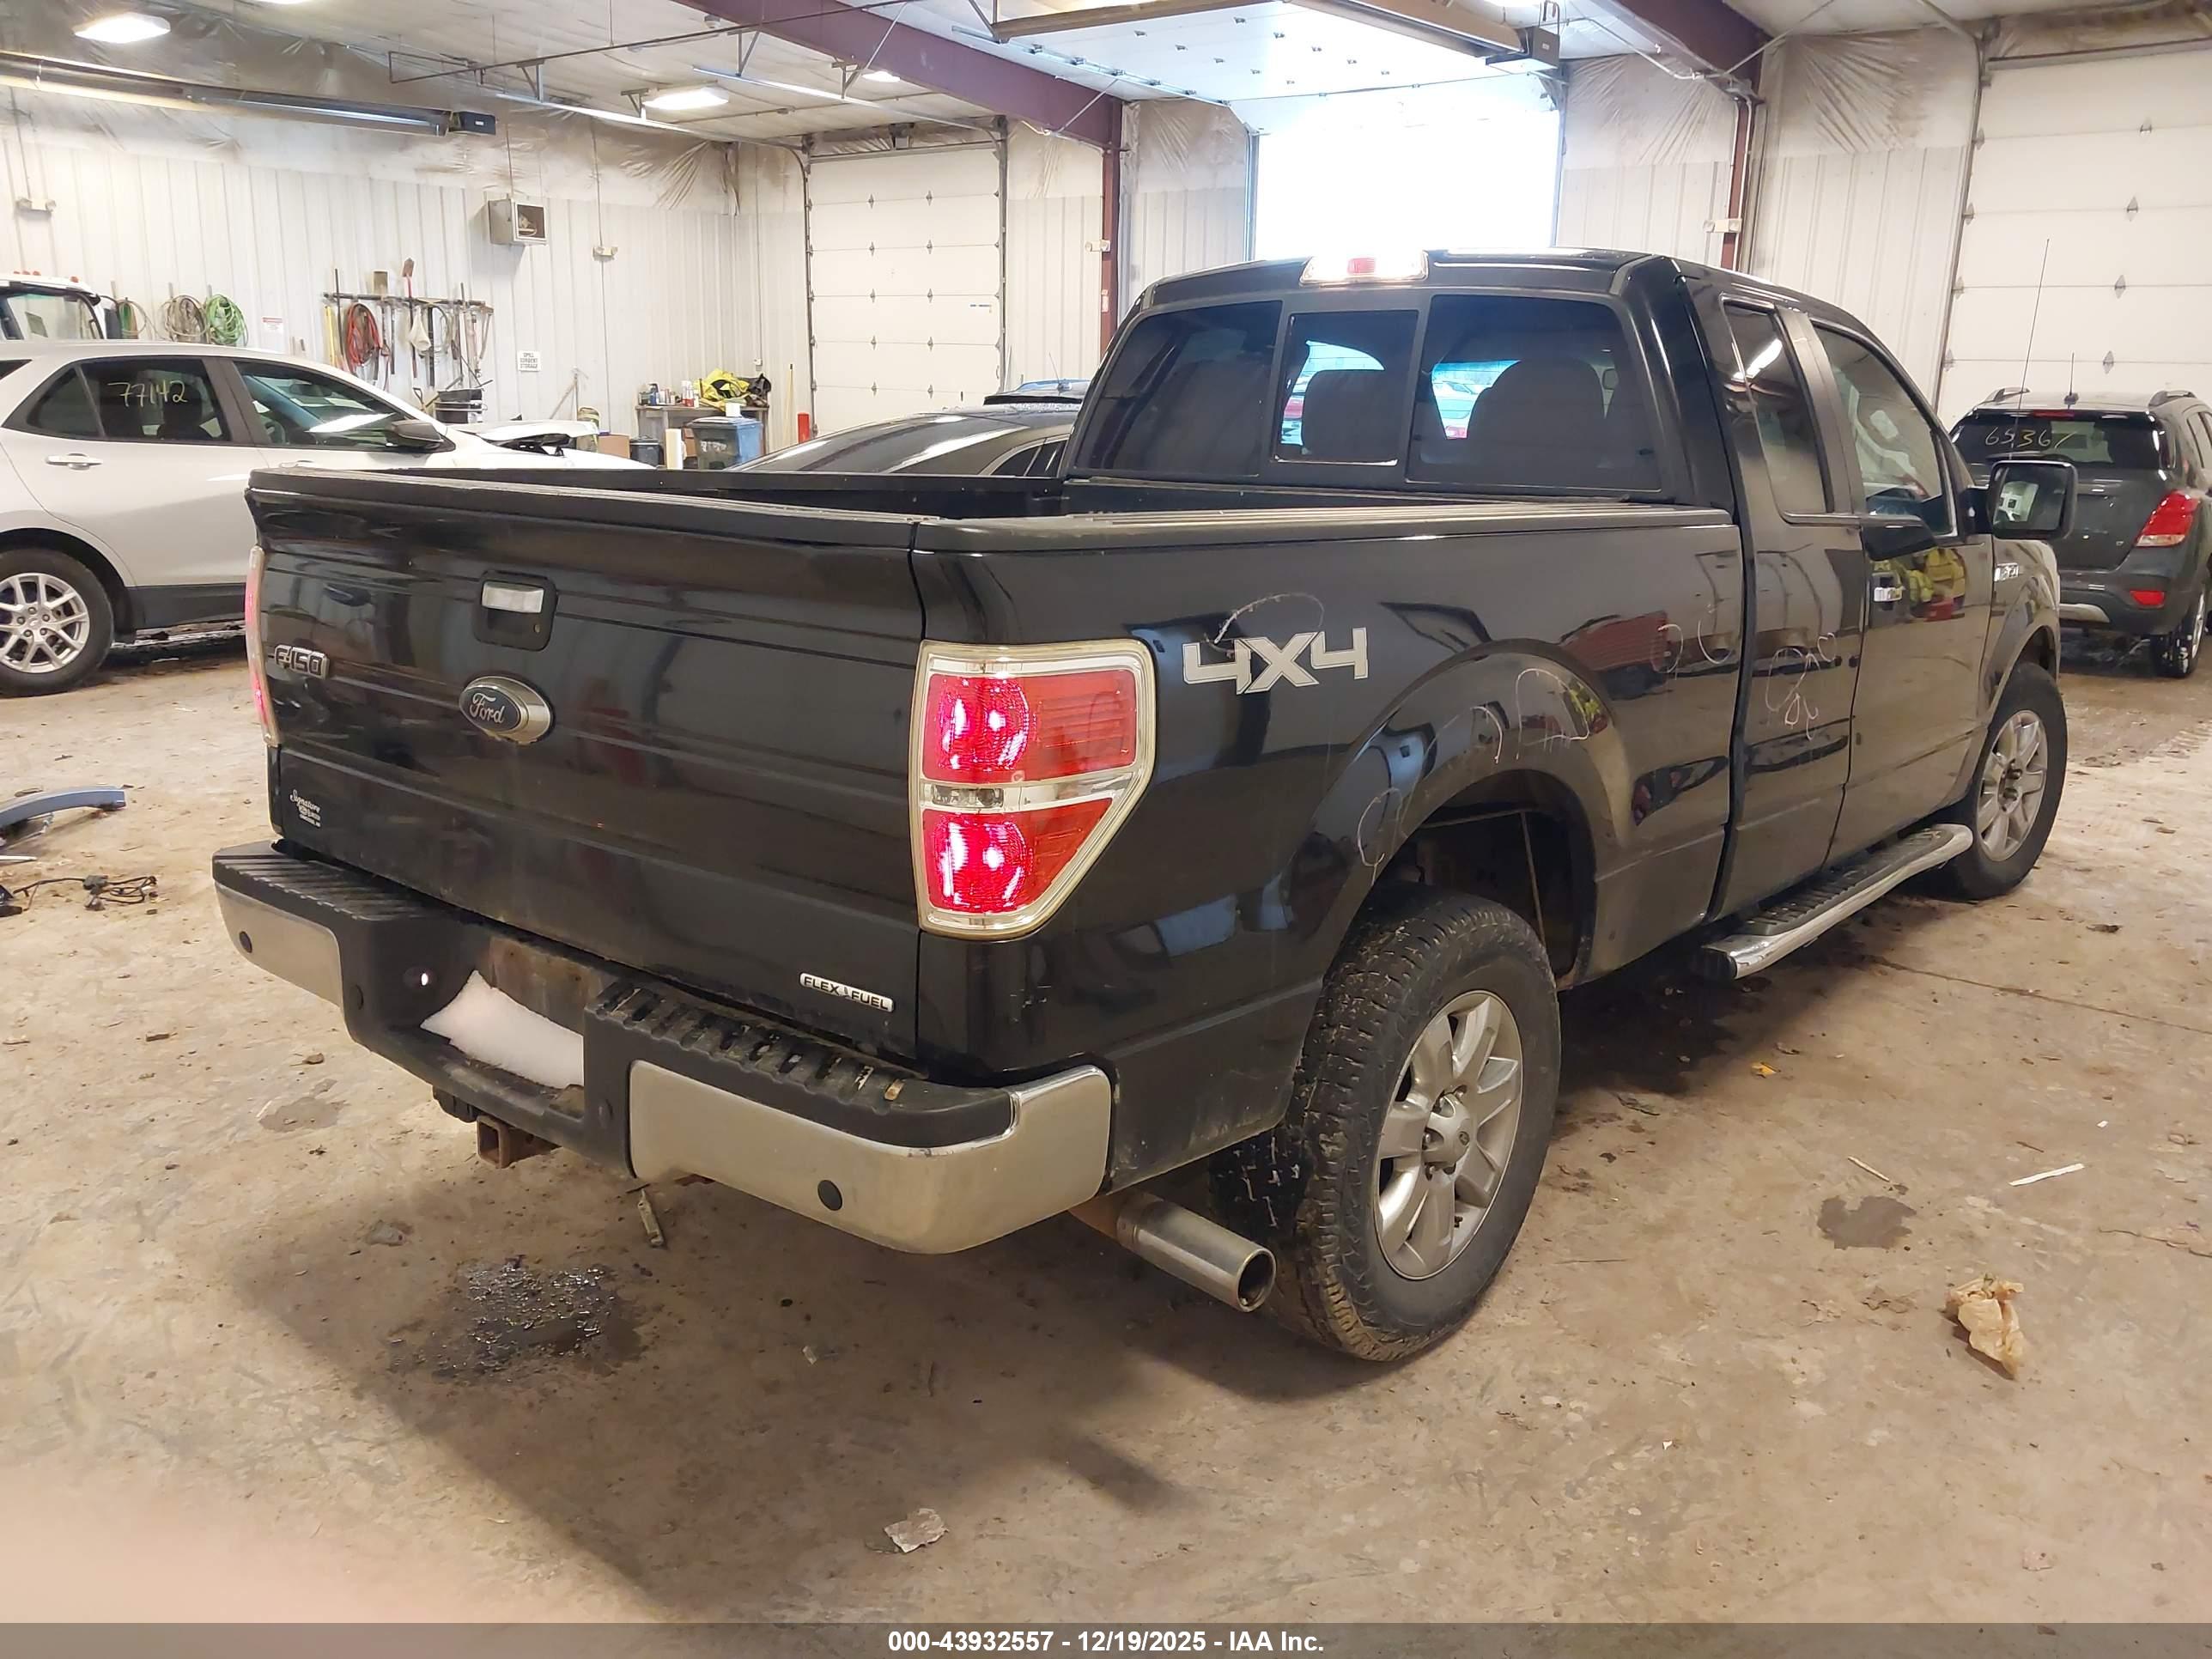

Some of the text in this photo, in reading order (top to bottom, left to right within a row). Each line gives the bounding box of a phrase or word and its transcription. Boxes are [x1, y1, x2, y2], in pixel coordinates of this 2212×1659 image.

[107, 380, 188, 407] 77142
[469, 692, 505, 724] Ford
[803, 975, 889, 1011] FLEX FUEL
